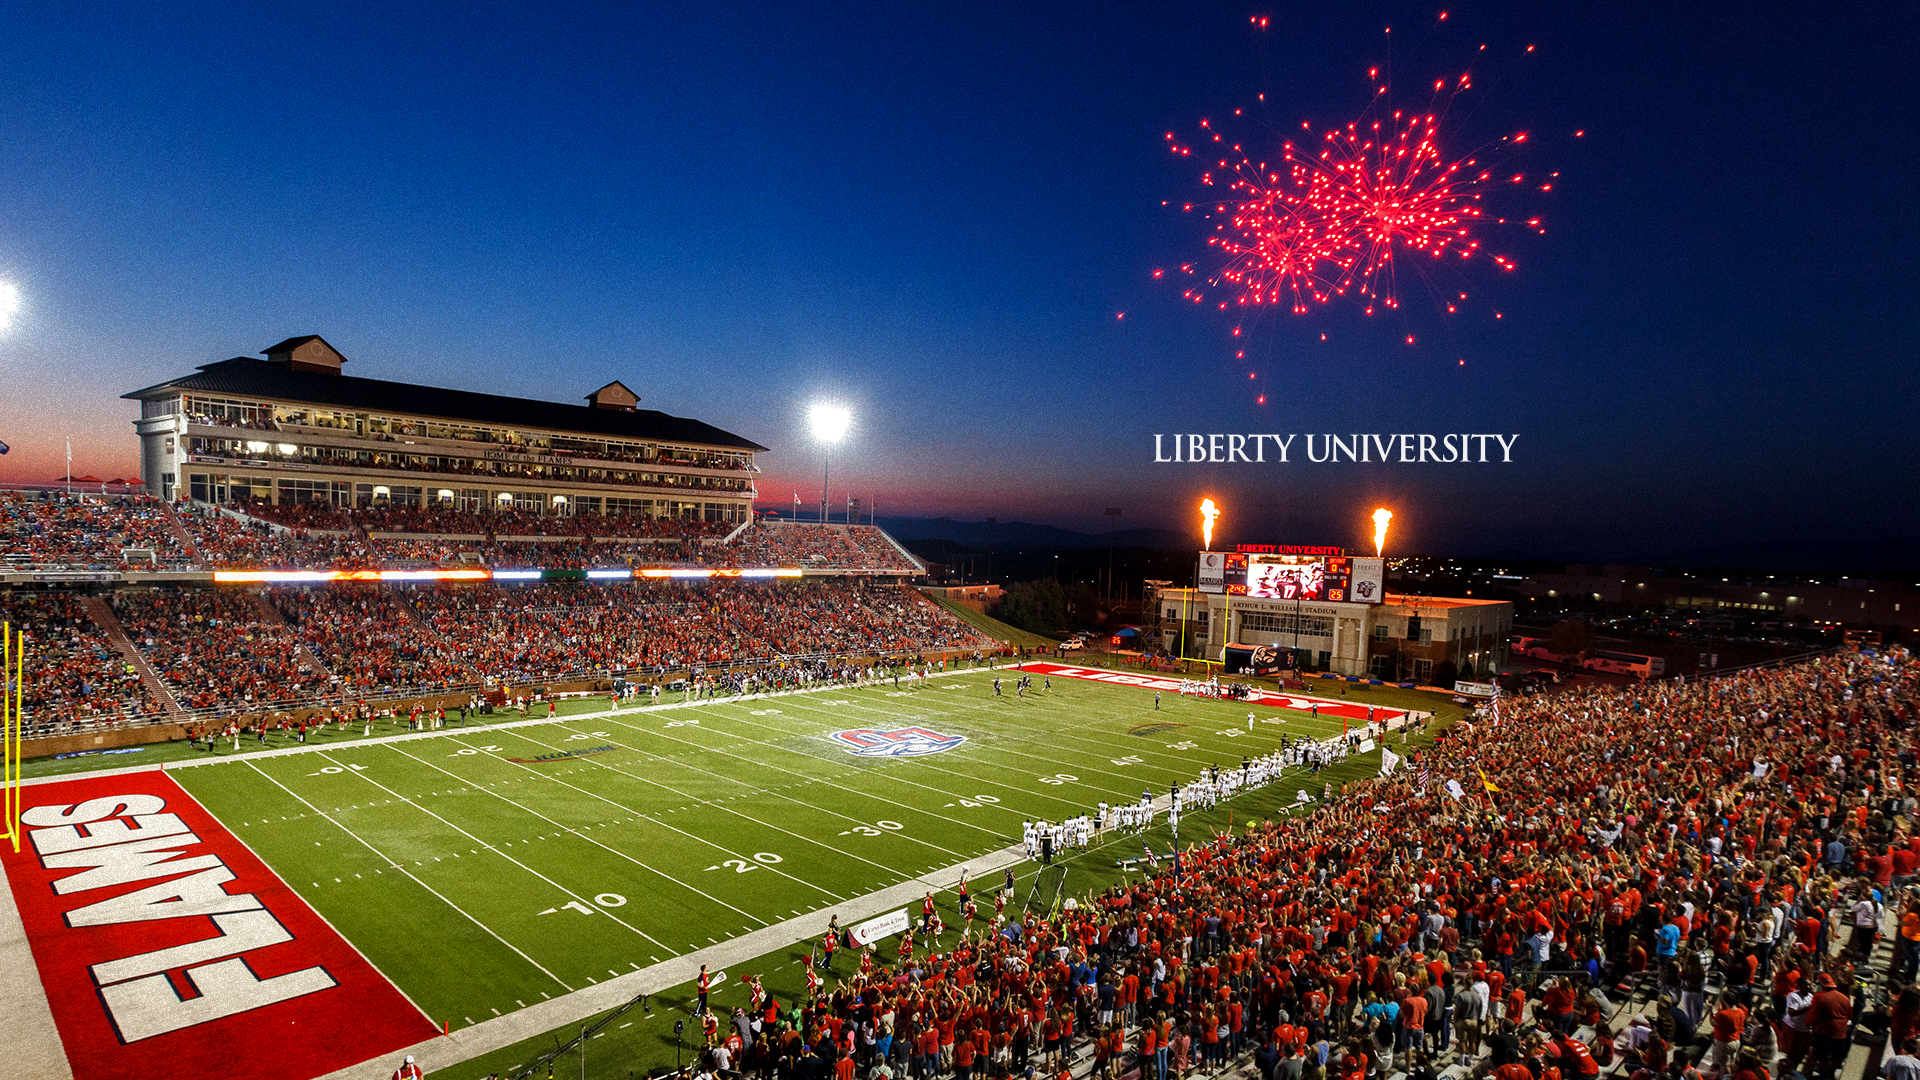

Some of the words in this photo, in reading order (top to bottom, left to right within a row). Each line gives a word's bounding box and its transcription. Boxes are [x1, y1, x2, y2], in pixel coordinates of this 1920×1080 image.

[483, 450, 510, 460] HOME
[523, 454, 535, 462] the
[538, 455, 573, 465] FLAMES
[1236, 543, 1276, 553] LIBERTY
[1279, 545, 1340, 555] UNIVERSITY
[1241, 560, 1247, 568] 9
[1331, 563, 1338, 572] 0
[1229, 583, 1246, 594] 2:42
[1283, 585, 1297, 599] 17
[1330, 590, 1342, 599] 25
[1232, 602, 1259, 610] ARTHUR
[1305, 607, 1337, 615] STADIUM
[1038, 774, 1079, 786] 50
[959, 795, 1000, 808] 40
[852, 820, 904, 837] 30
[723, 852, 784, 874] 20
[561, 893, 627, 916] 10
[20, 794, 340, 1046] FLAMES
